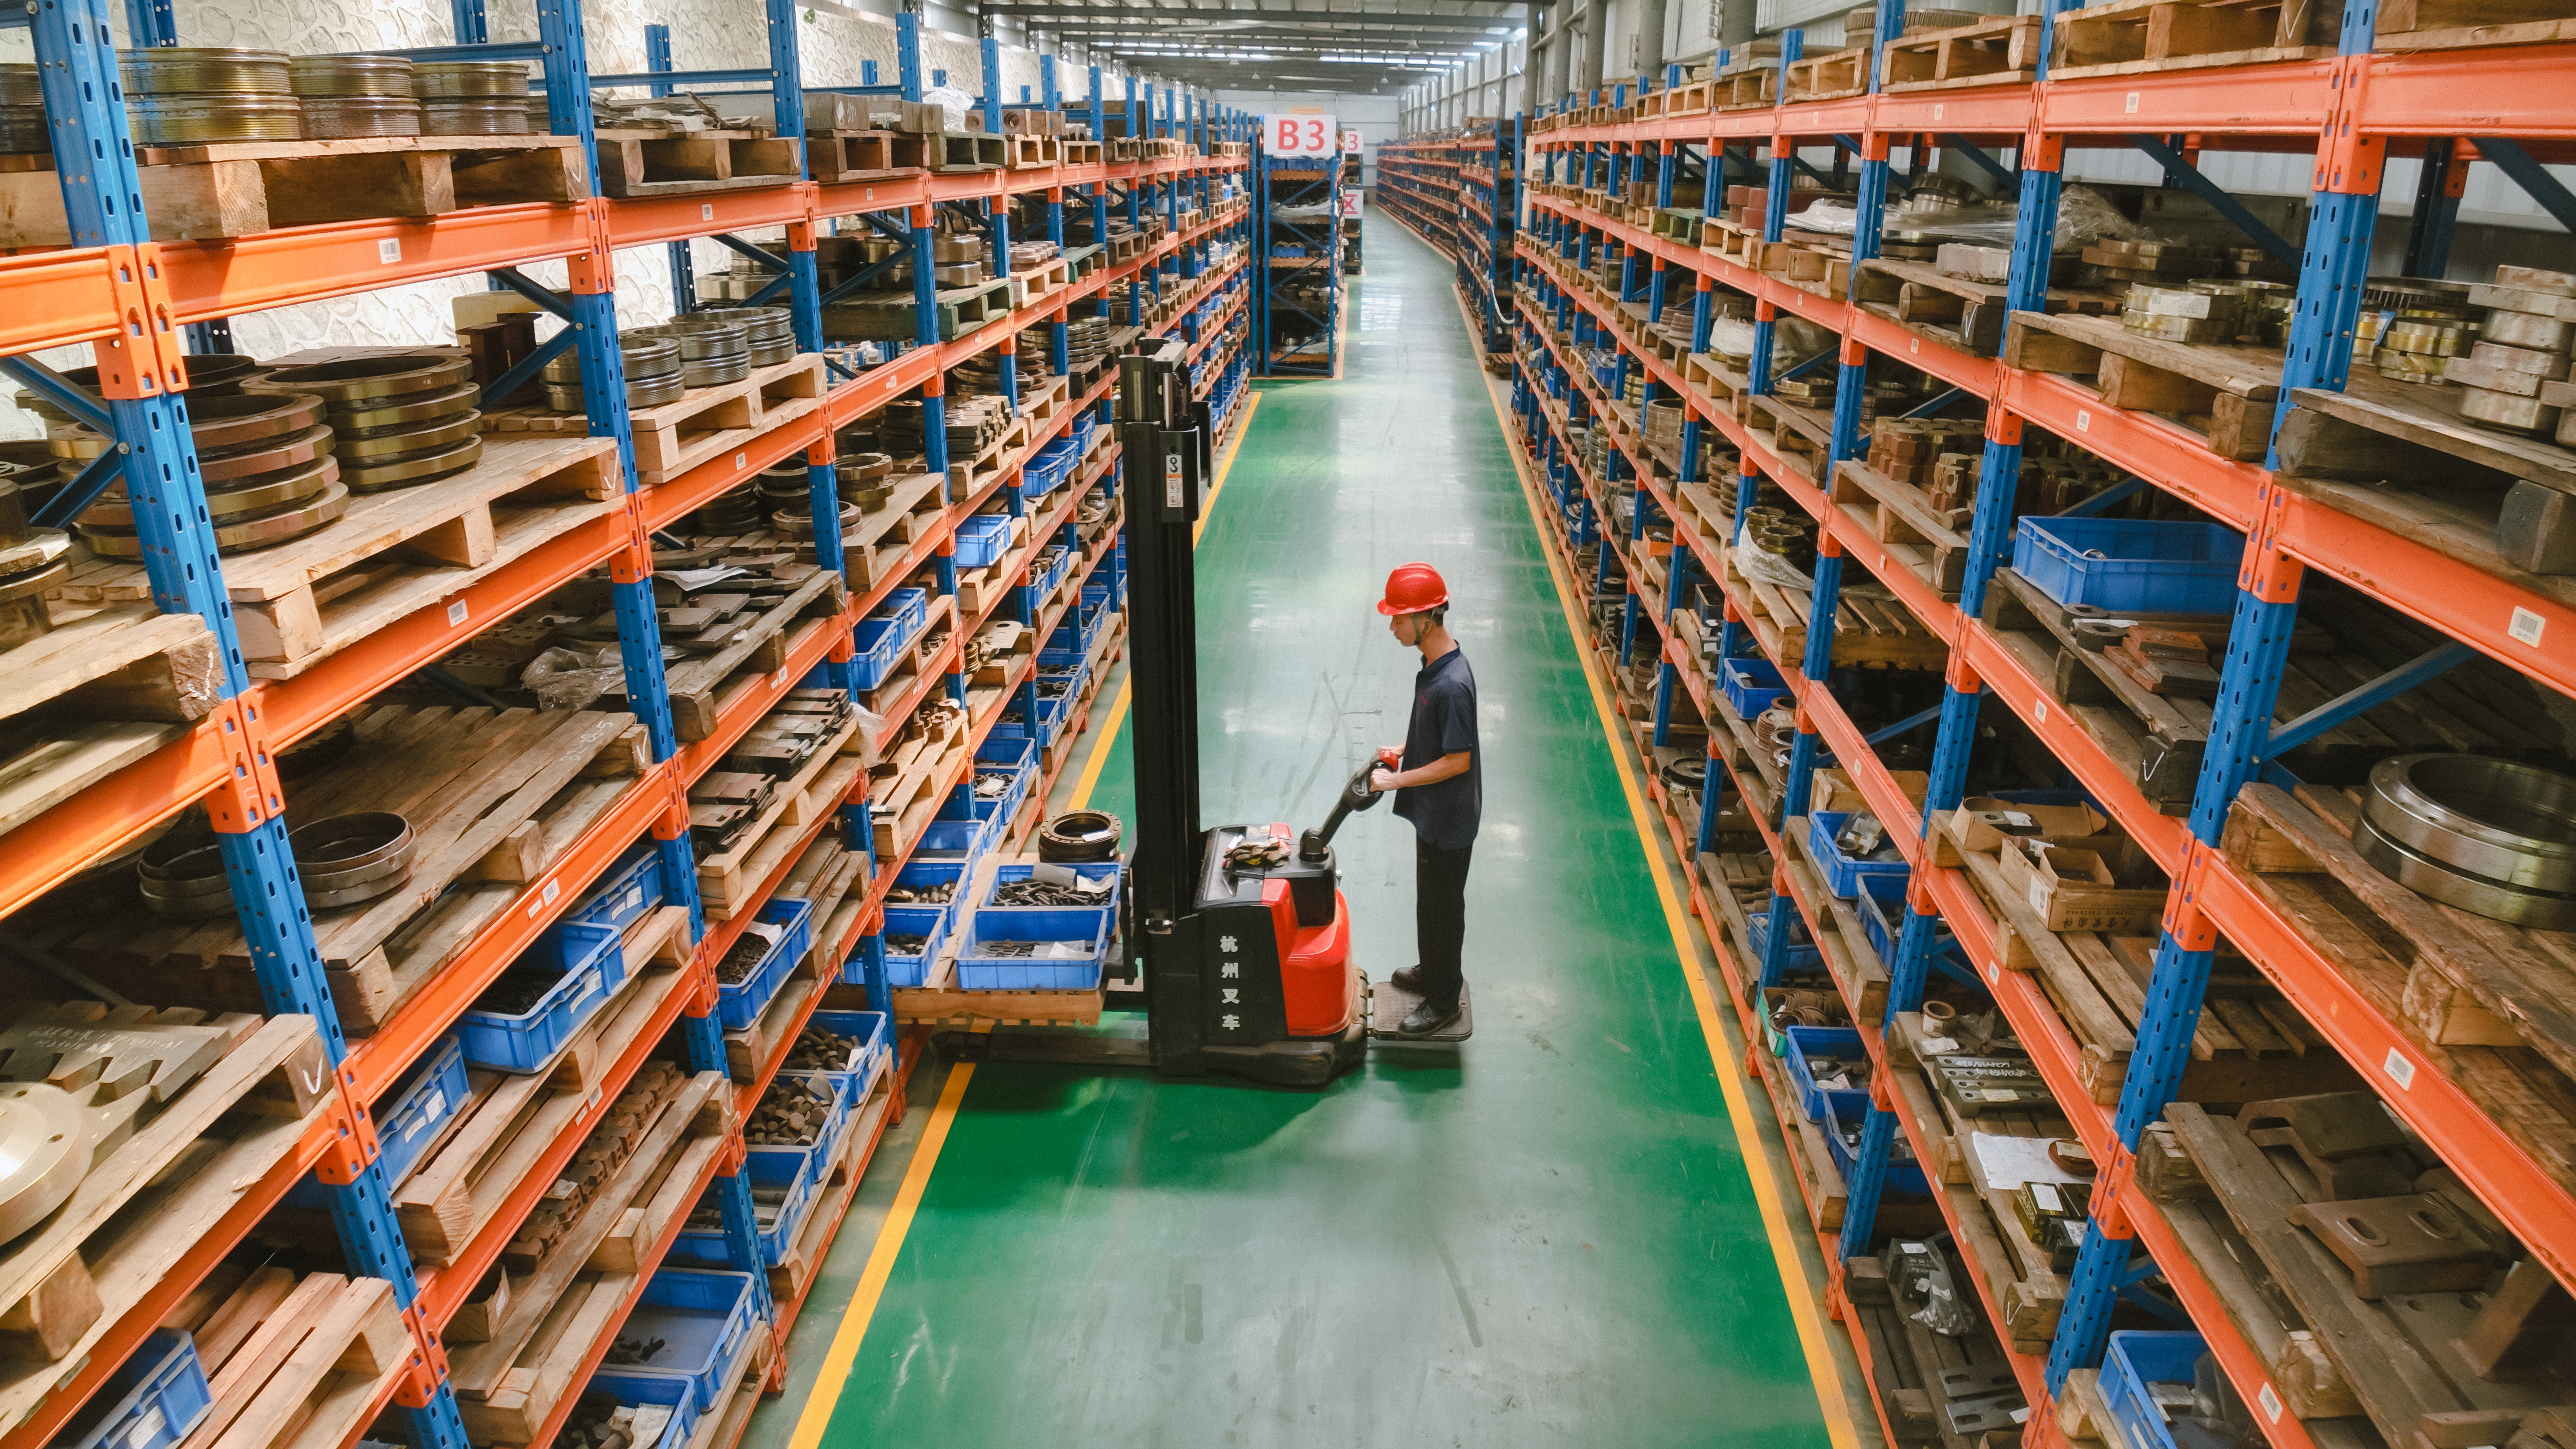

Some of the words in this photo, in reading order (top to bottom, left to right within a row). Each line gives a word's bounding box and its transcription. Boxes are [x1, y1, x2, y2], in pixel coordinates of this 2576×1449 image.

[1278, 119, 1325, 151] B3
[1348, 133, 1359, 151] 3
[1220, 935, 1241, 1030] 杭州叉车
